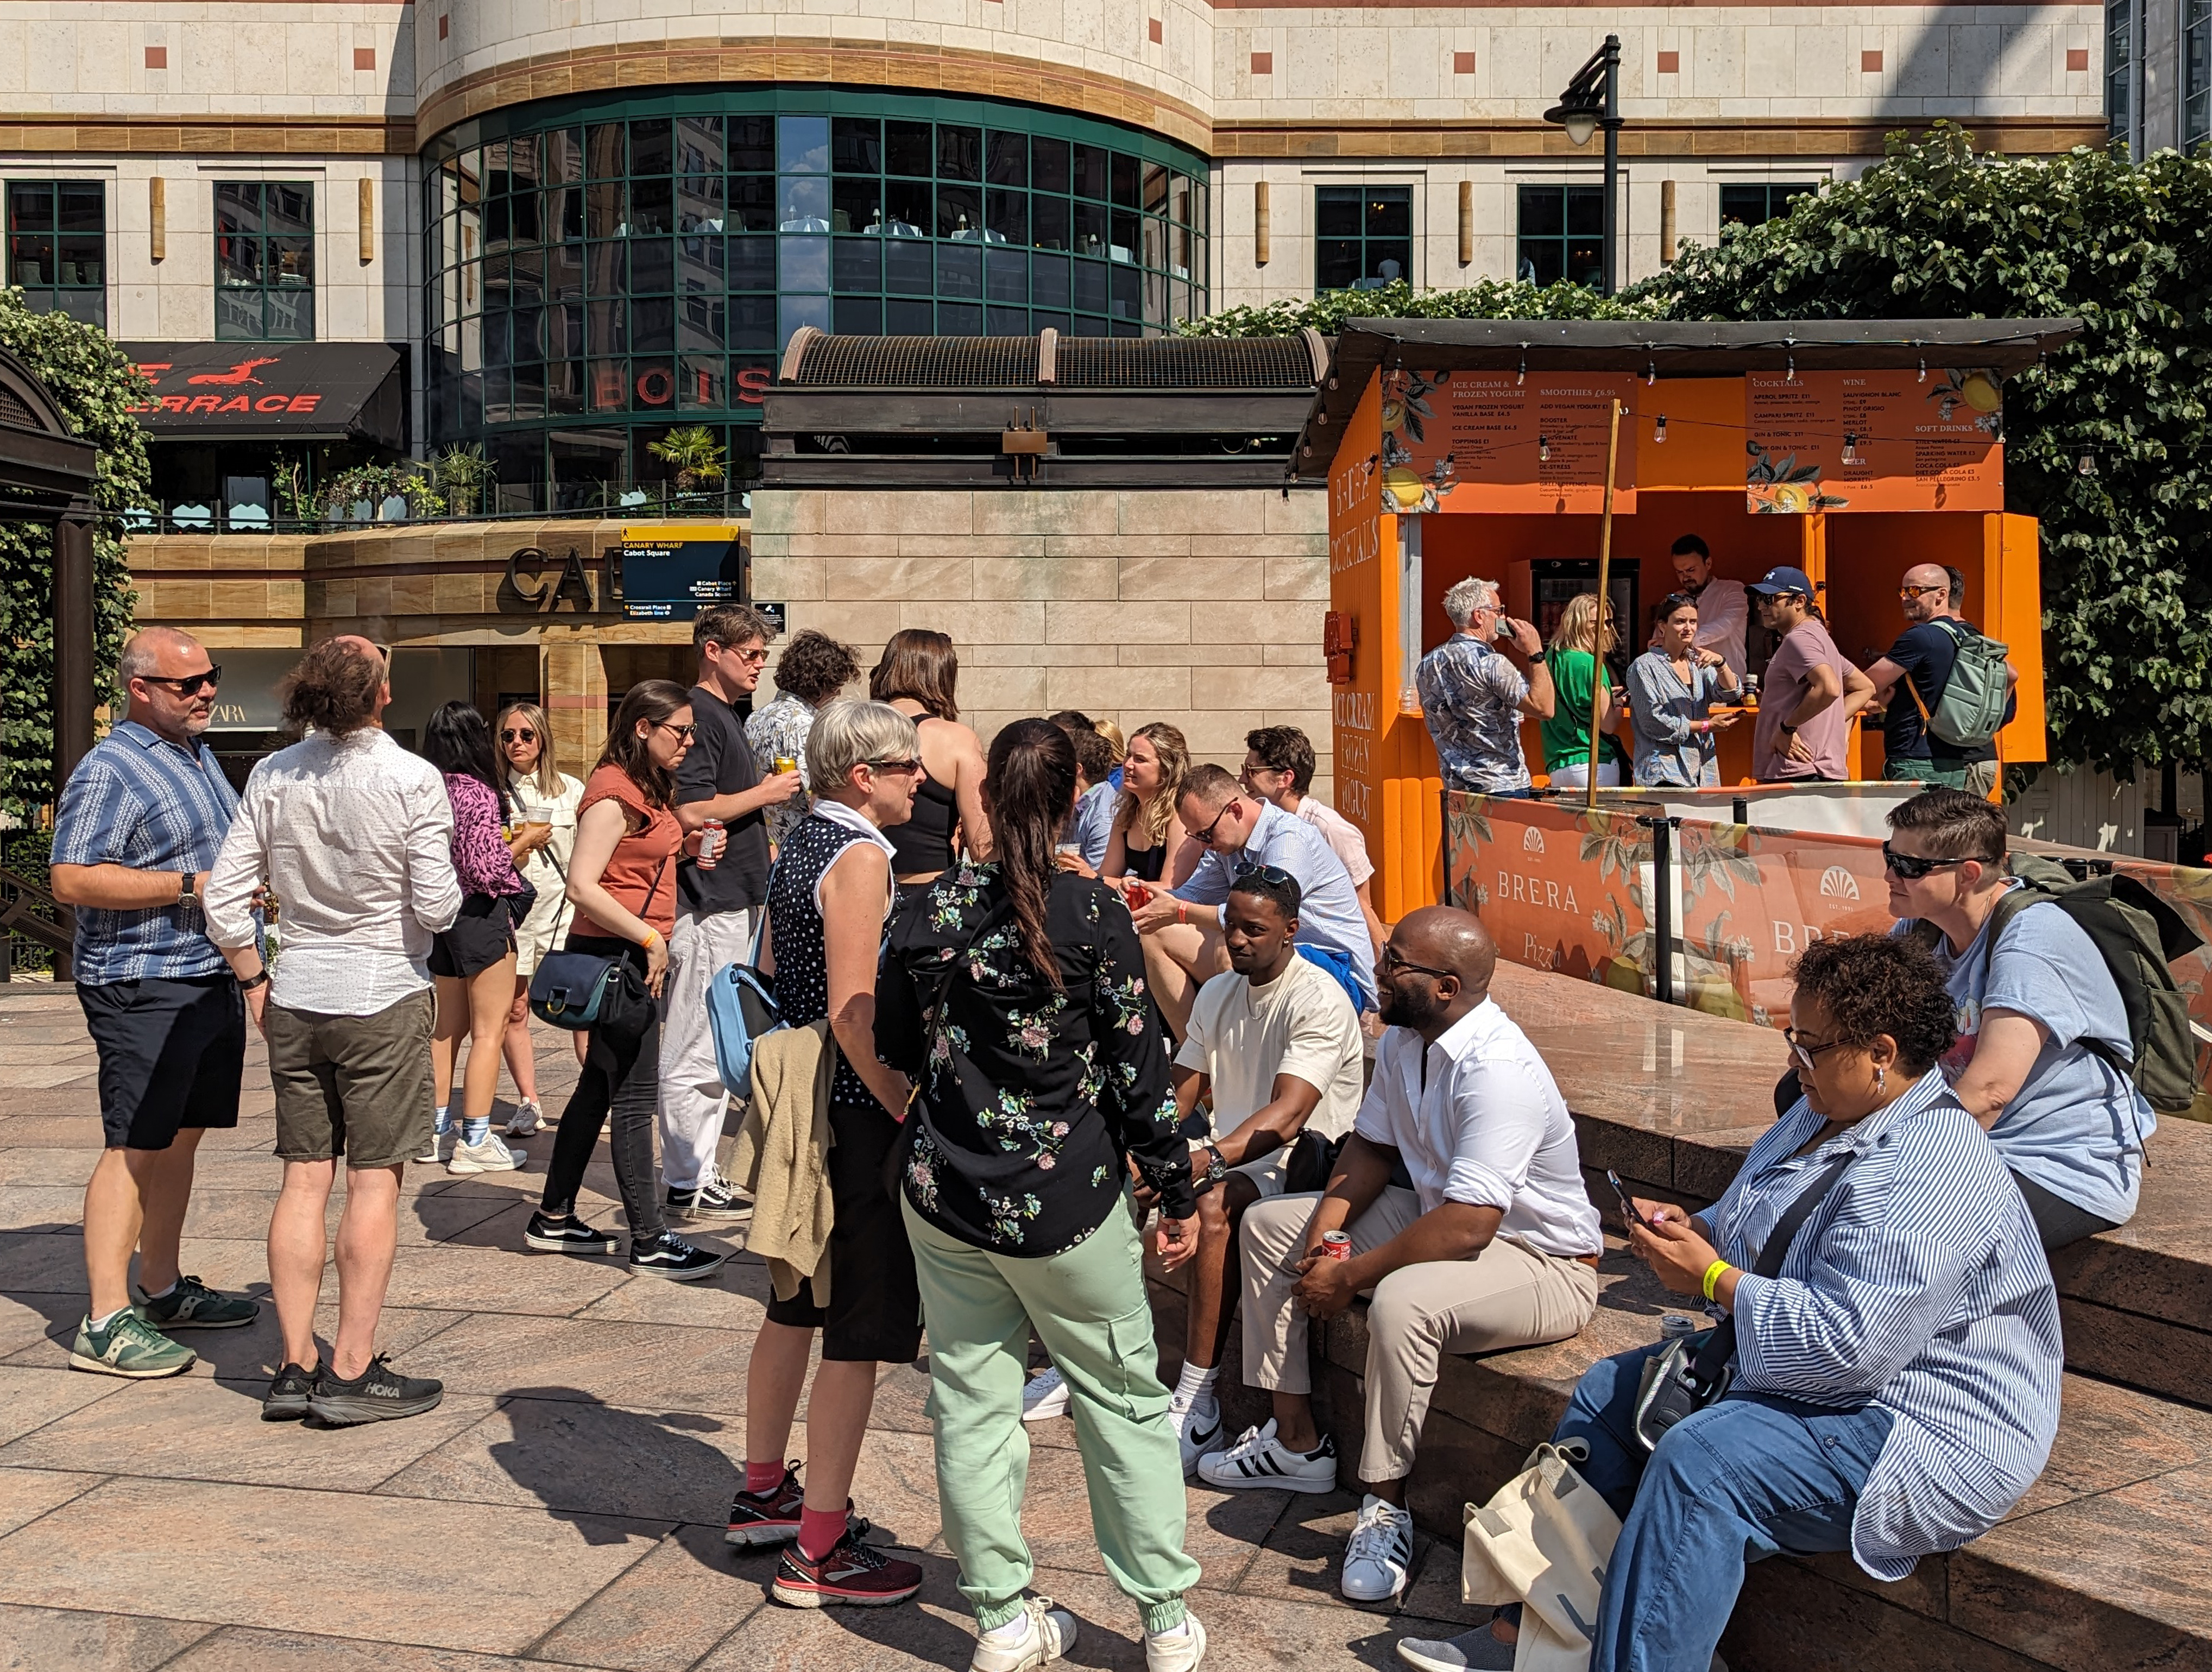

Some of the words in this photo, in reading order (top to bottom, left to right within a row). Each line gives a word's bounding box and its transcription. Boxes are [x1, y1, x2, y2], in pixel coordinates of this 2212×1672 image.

[125, 394, 322, 413] RRACE
[1595, 389, 1616, 398] £6.95
[646, 550, 671, 558] Square
[1331, 515, 1378, 575] COCKTAILS
[209, 705, 247, 723] ZARA
[1334, 692, 1346, 727] ICE
[1347, 692, 1375, 731] CREAM
[1341, 733, 1370, 777] FROZEN
[1340, 775, 1372, 825] YOGURT
[1497, 871, 1580, 914] BRERA
[1523, 932, 1561, 970] Pizza
[364, 1382, 400, 1398] HOKA
